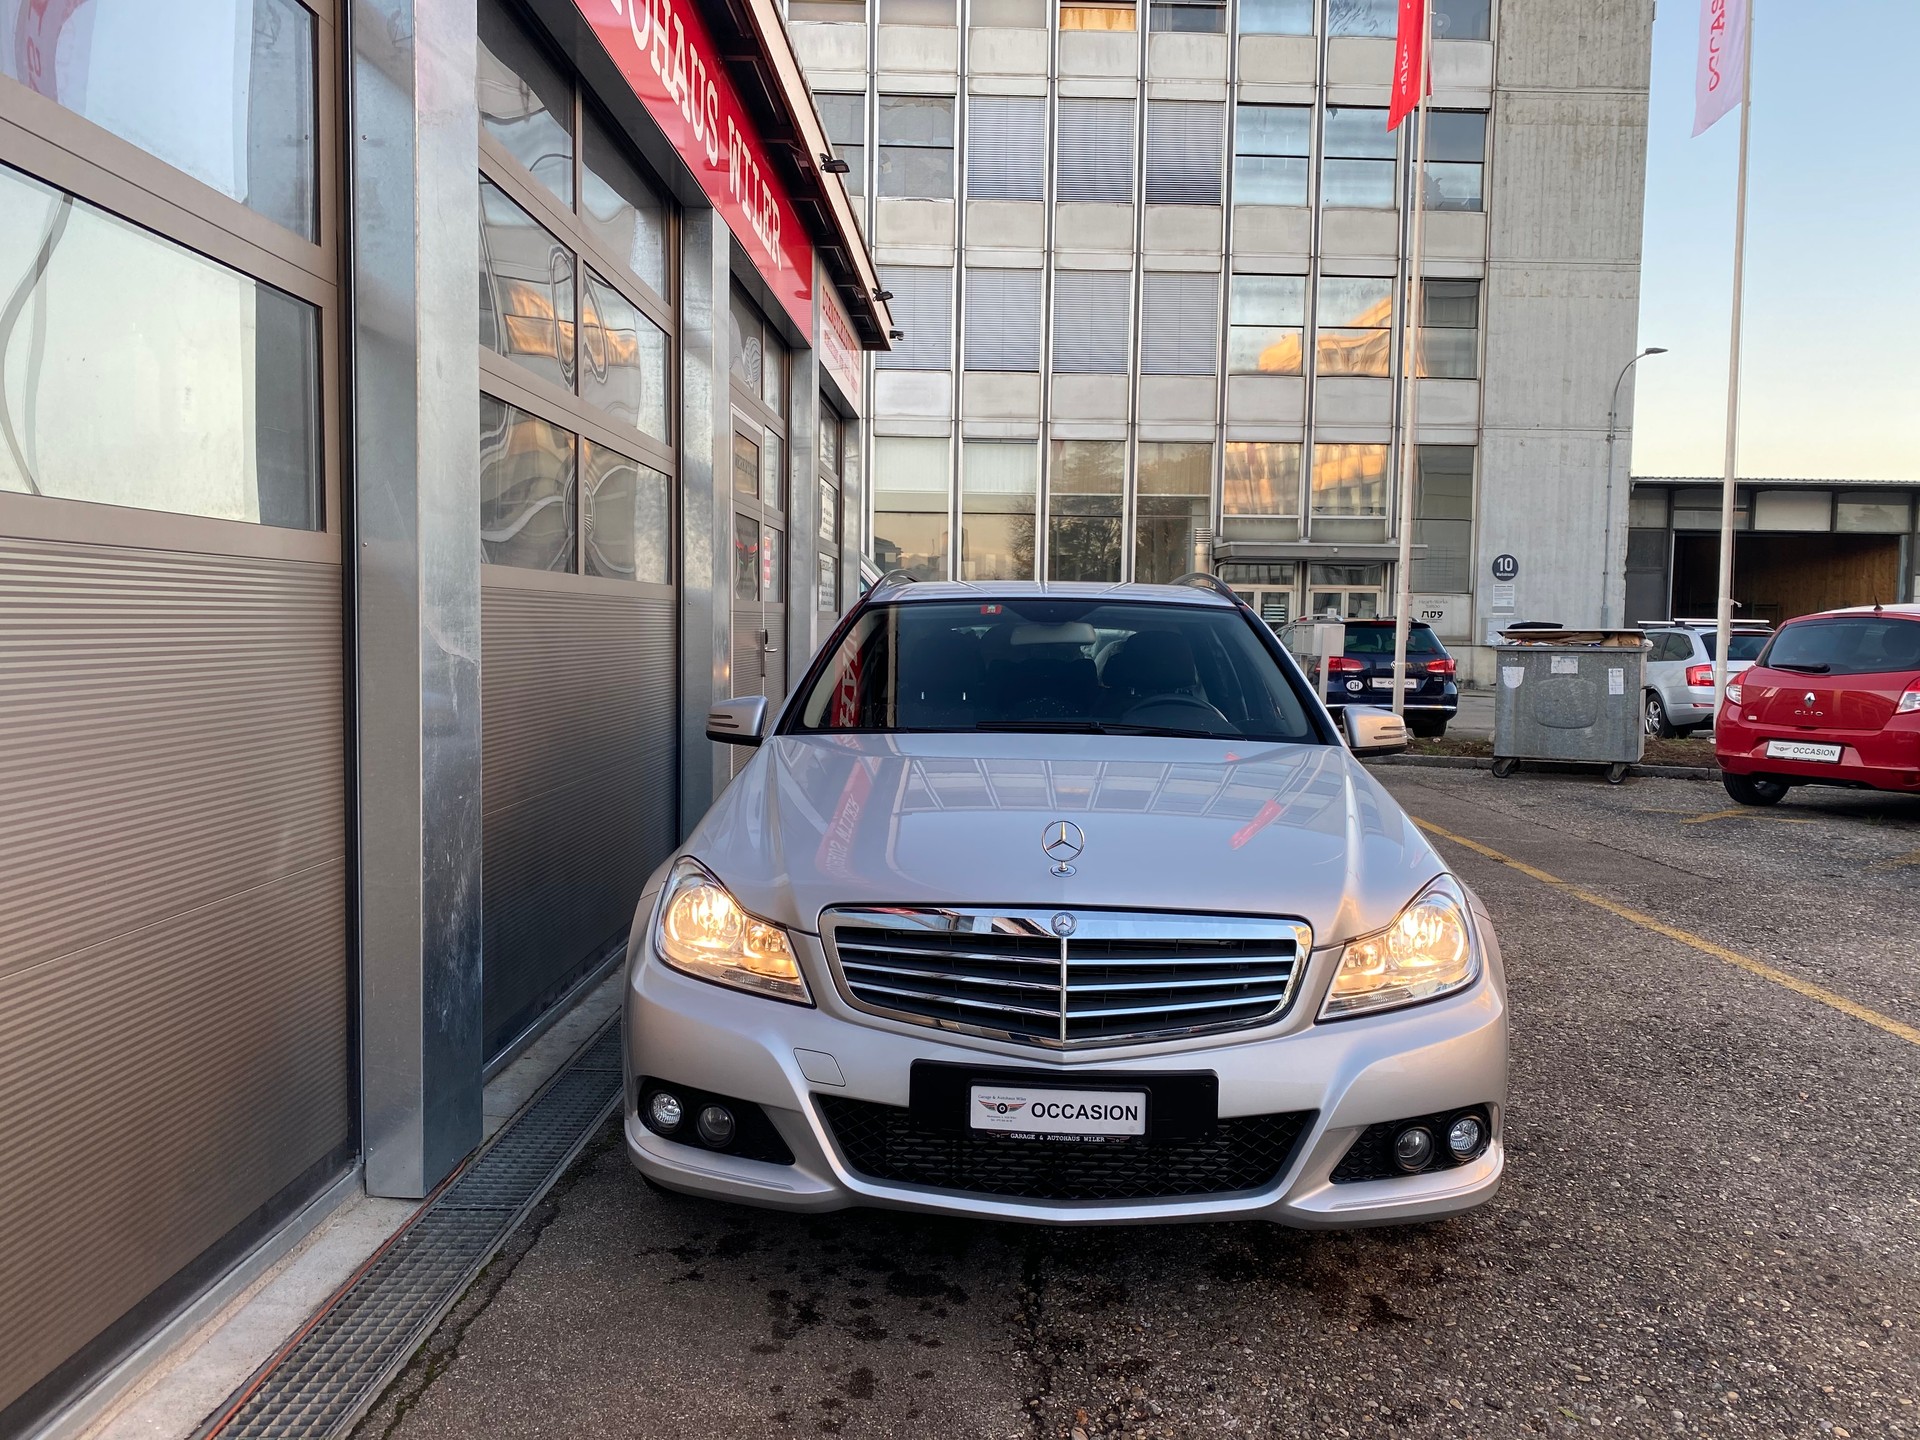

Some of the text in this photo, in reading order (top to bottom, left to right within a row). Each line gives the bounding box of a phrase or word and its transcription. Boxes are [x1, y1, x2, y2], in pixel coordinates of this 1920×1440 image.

[728, 115, 782, 271] WILER
[1497, 557, 1514, 572] 10
[1349, 680, 1360, 690] CH
[1793, 747, 1835, 756] OCCASION
[1031, 1102, 1138, 1121] OCCASION
[1010, 1132, 1036, 1140] GARAGE
